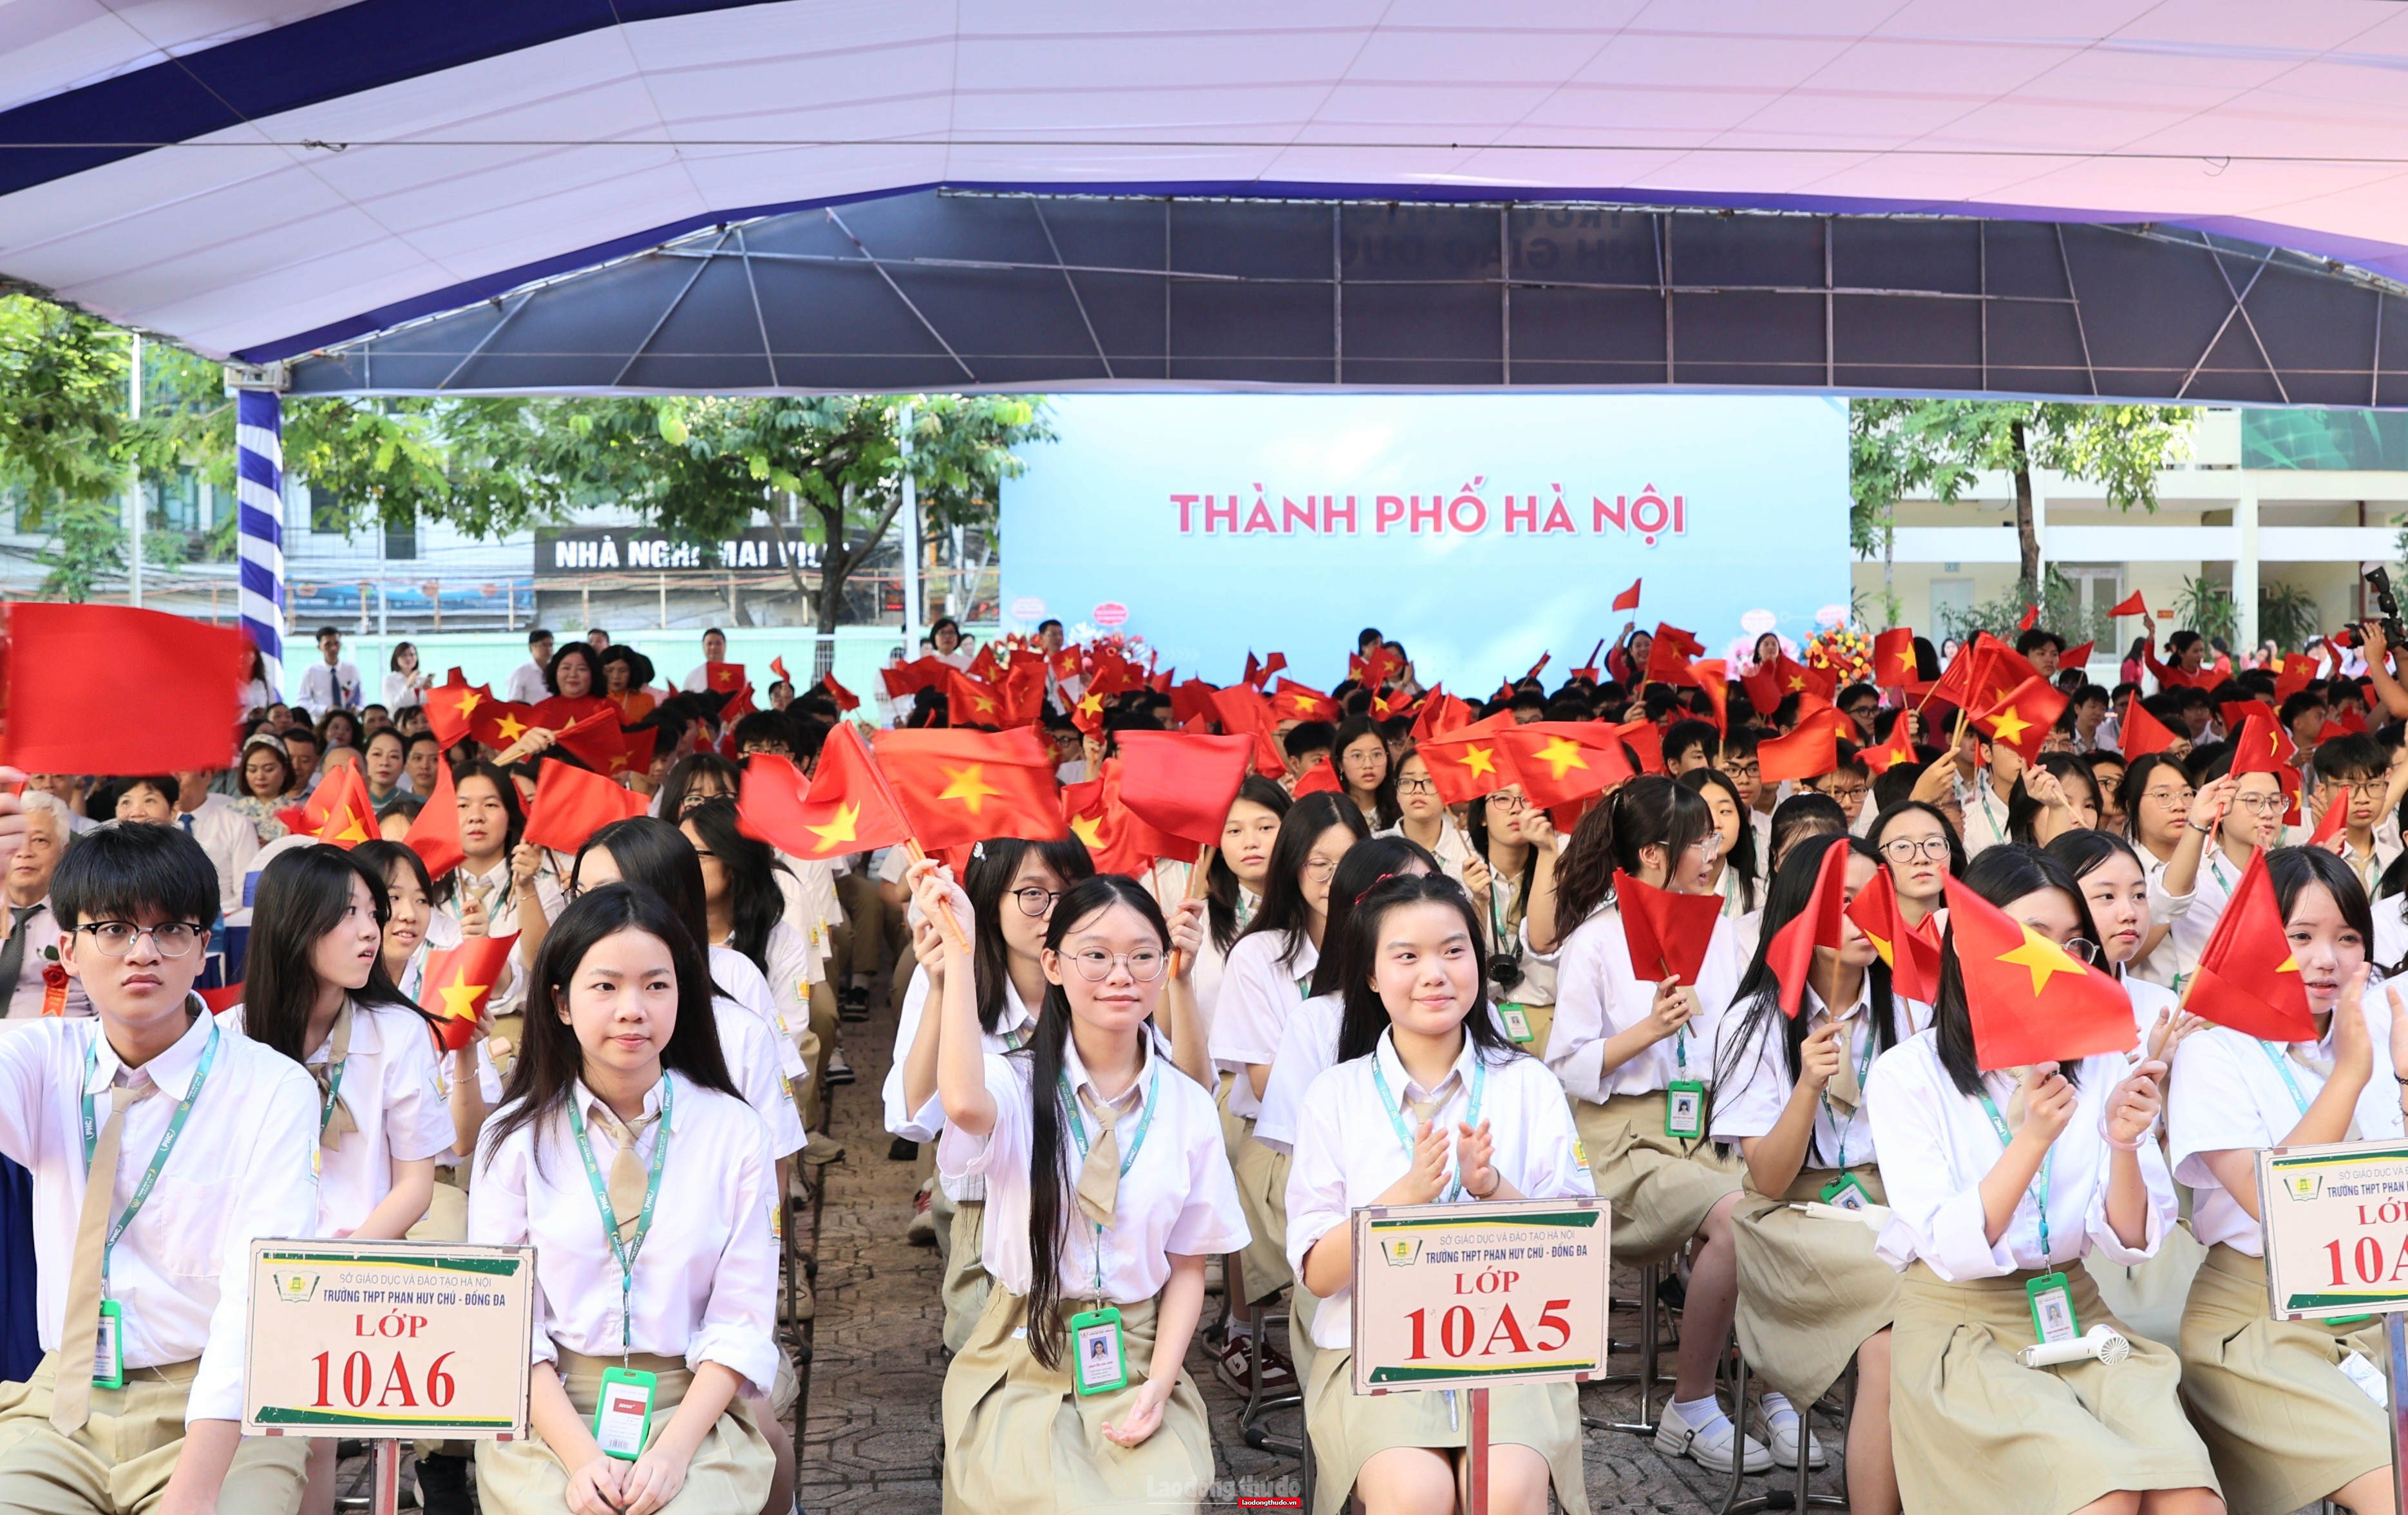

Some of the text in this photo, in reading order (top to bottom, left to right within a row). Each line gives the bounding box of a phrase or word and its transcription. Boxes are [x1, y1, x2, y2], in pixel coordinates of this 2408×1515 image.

[1170, 475, 1683, 545] THÀNH PHỐ HÀ NỘI
[555, 536, 619, 567] NHÀ
[84, 1120, 94, 1136] PHC
[162, 1131, 175, 1149] PHC
[2339, 1165, 2404, 1180] SỞ GIÁO DỤC VÀ
[2327, 1181, 2405, 1198] TRƯỜNG THPT PHAN
[598, 1194, 611, 1210] PHC
[644, 1192, 654, 1209] PHC
[1440, 1234, 1452, 1245] SỞ
[1477, 1233, 1494, 1244] DỤC
[1497, 1231, 1507, 1243] VÀ
[1510, 1230, 1528, 1242] ĐÀO
[1530, 1231, 1545, 1243] TẠO
[1548, 1229, 1559, 1240] HÀ
[1560, 1229, 1575, 1240] NỘI
[1426, 1249, 1458, 1263] TRƯỜNG
[1461, 1250, 1481, 1262] THPT
[1484, 1248, 1506, 1261] PHAN
[1509, 1248, 1525, 1259] HUY
[1527, 1244, 1543, 1259] CHÚ
[1551, 1242, 1574, 1258] ĐỐNG
[1577, 1245, 1588, 1256] ĐA
[339, 1274, 492, 1288] SỞ GIÁO DỤC VÀ ĐÀO TẠO HÀ NỘI
[1454, 1265, 1520, 1295] LỚP
[324, 1287, 359, 1302] TRƯỜNG
[363, 1290, 385, 1303] THPT
[388, 1292, 413, 1304] PHAN
[417, 1292, 435, 1304] HUY
[437, 1290, 455, 1305] CHÚ
[465, 1290, 490, 1306] ĐỐNG
[493, 1294, 506, 1306] ĐA
[356, 1308, 428, 1338] LỚP
[1403, 1299, 1571, 1360] 10A5
[310, 1350, 455, 1407] 10A6
